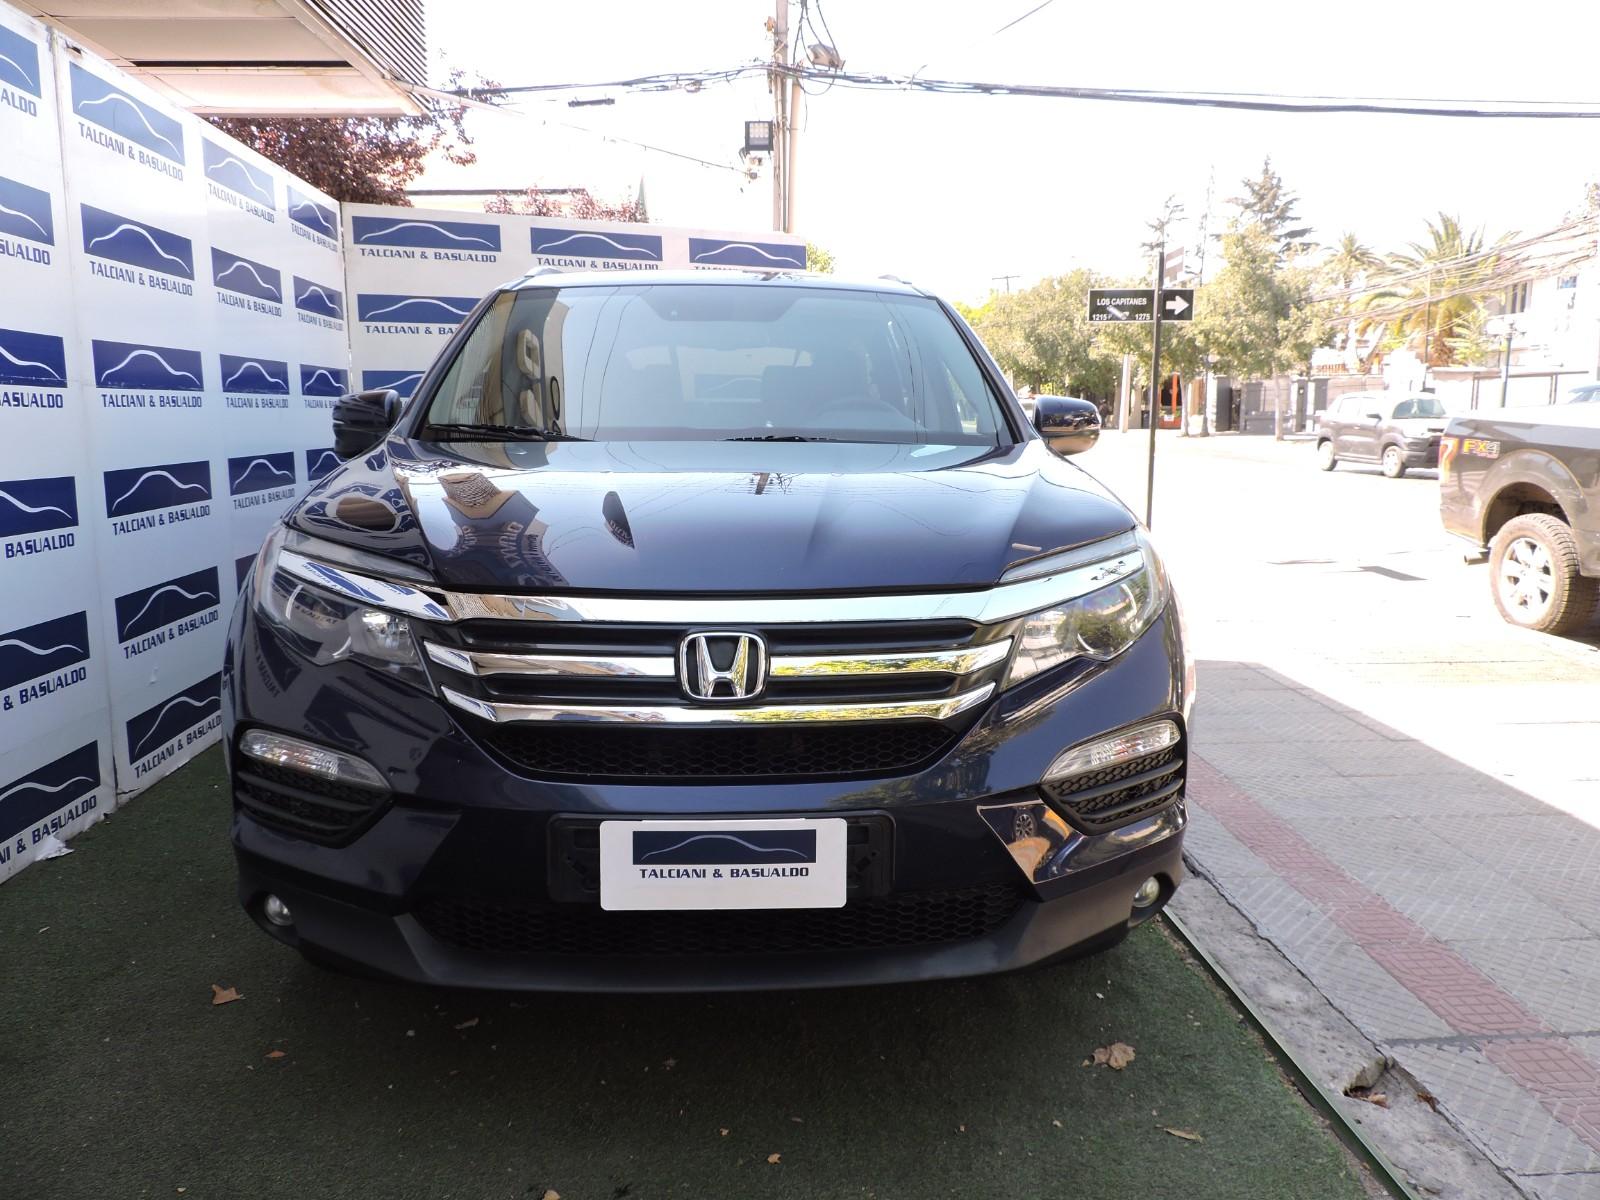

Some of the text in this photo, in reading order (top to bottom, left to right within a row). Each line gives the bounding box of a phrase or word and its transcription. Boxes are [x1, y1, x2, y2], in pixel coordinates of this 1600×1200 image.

[78, 121, 184, 182] TALCIANI & BASUALDO
[208, 183, 237, 206] TALCIANI
[246, 202, 275, 223] BASUALDO
[360, 248, 497, 263] TALCIANI & BASUALDO
[537, 257, 586, 268] TALCIANI
[590, 260, 598, 269] &
[89, 261, 193, 296] TALCIANI & BASUALDO
[217, 292, 245, 309] TALCIANI
[253, 300, 282, 317] BASUALDO
[1096, 298, 1147, 306] LOS CAPITANES
[365, 325, 419, 334] TALCIANI
[424, 326, 432, 335] &
[0, 391, 63, 408] ASUALDO
[101, 394, 202, 408] TALCIANI & BASUALDO
[226, 397, 253, 408] TALCIANI
[262, 398, 288, 408] BASUALDO
[1464, 439, 1500, 454] FX4
[112, 505, 210, 536] TALCIANI & BASUALDO
[5, 533, 75, 558] BASUALDO
[124, 609, 219, 659] TALCIANI & BASUALDO
[3, 666, 87, 711] & BASUALDO
[134, 715, 223, 779] TALCIANI & BASUALD
[16, 795, 97, 854] & BASUALDO
[639, 867, 809, 879] TALCIANI & BASUALDO
